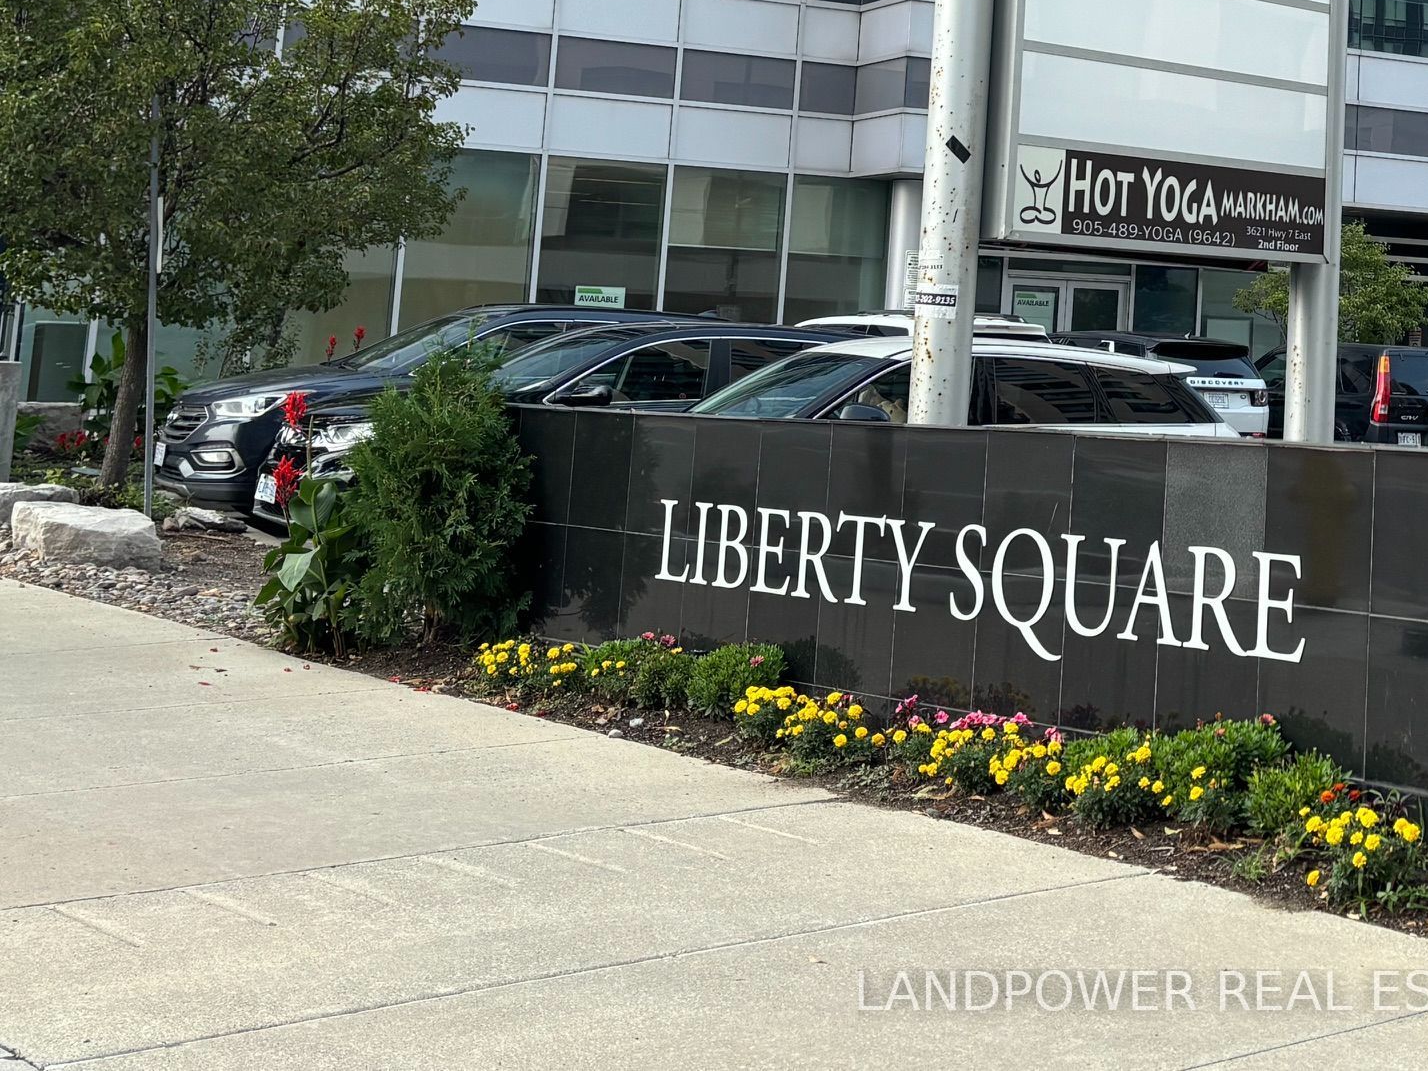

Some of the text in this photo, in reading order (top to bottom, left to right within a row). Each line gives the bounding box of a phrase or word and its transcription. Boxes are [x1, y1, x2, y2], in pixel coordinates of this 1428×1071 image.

[1068, 158, 1324, 226] HOT YOGA MARKHAM.COM
[1072, 219, 1236, 248] 905-489-YOGA (9642)
[1246, 225, 1311, 241] 3621 Hwy 7 East
[1258, 239, 1299, 251] 2nd Floor
[578, 295, 619, 303] AVAILABLE
[1017, 299, 1049, 307] AVAILABLE
[655, 499, 1307, 664] LIBERTY SQUARE
